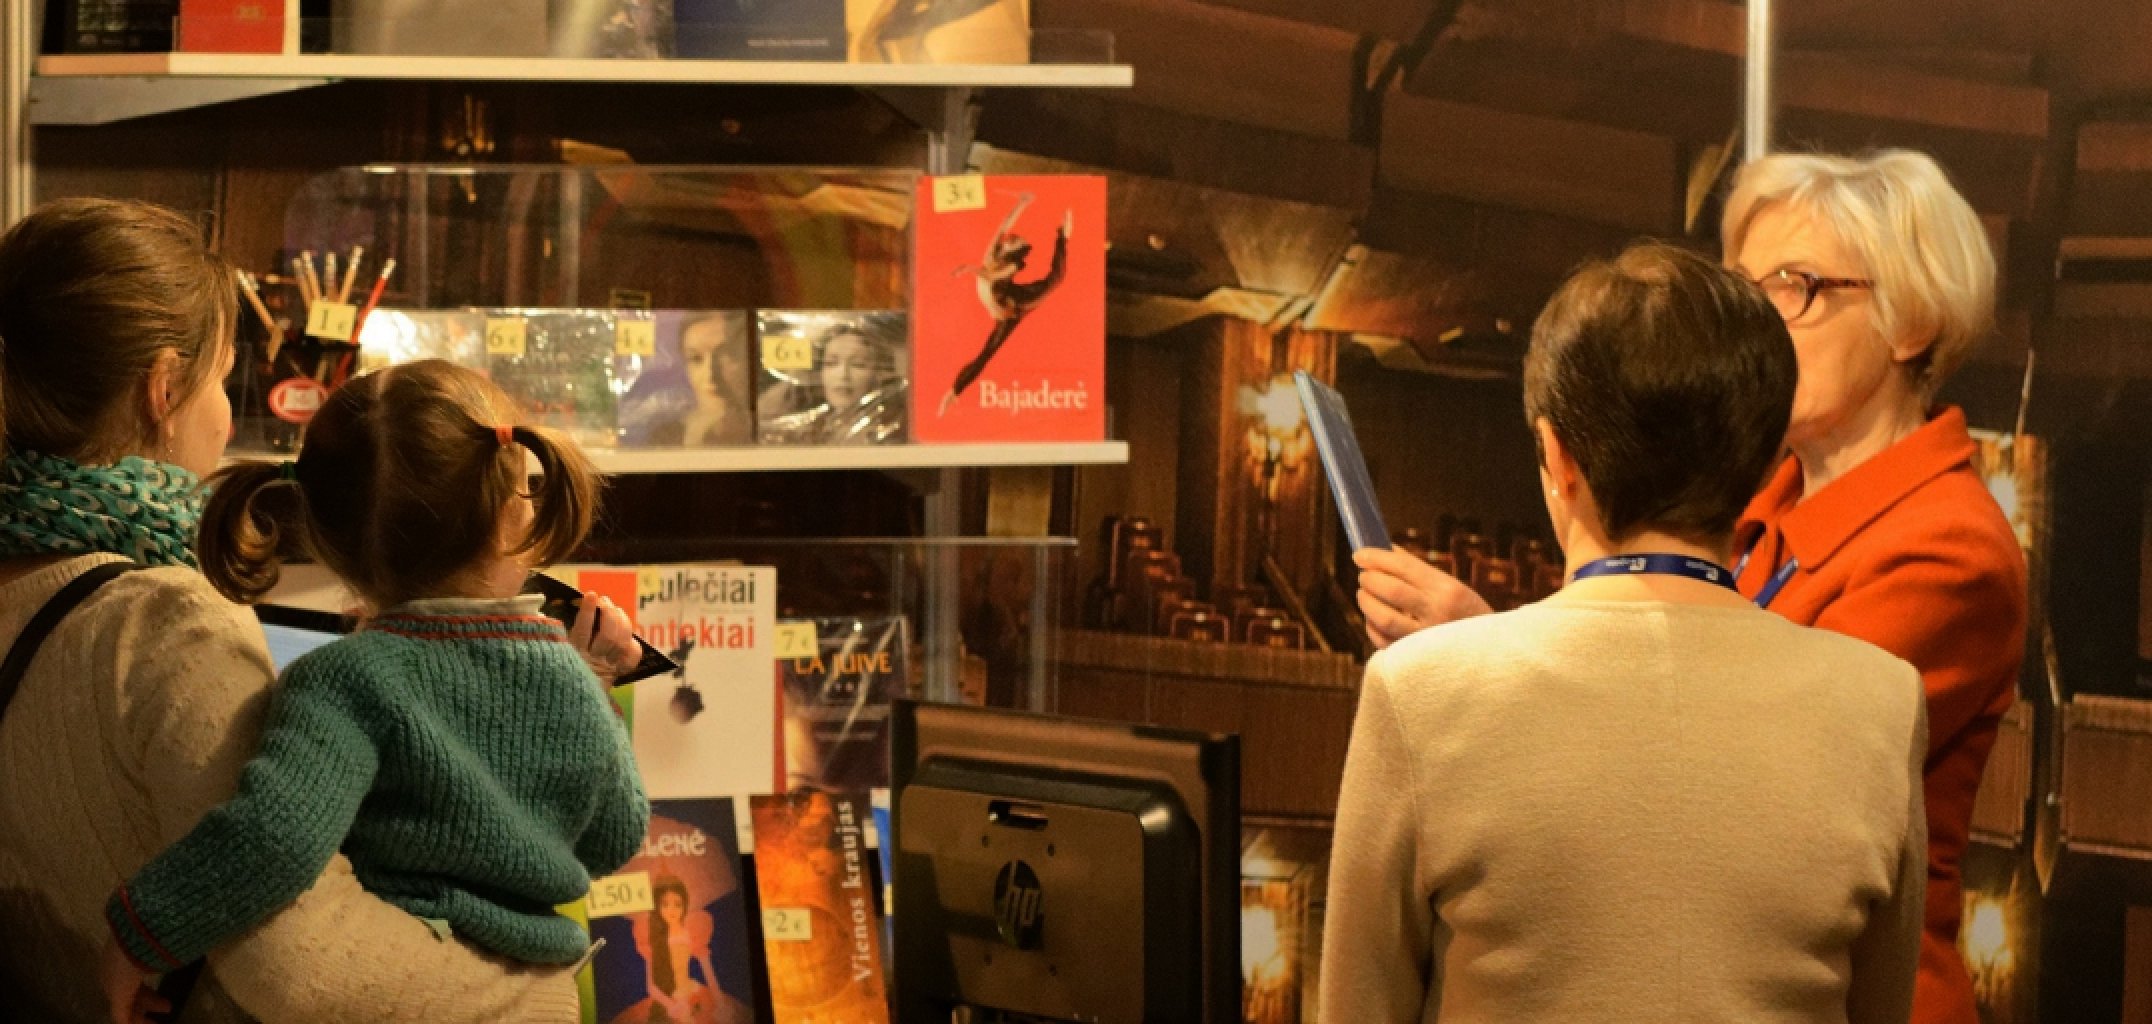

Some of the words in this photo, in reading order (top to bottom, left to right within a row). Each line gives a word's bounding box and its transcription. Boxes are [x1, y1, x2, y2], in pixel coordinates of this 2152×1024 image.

[946, 182, 961, 205] 3
[319, 308, 329, 332] 1
[489, 325, 503, 348] 6
[775, 342, 789, 361] 6
[980, 379, 1089, 416] Bajaderė
[781, 629, 795, 652] 7
[793, 656, 825, 675] LA
[832, 652, 893, 675] JUIVE
[834, 801, 862, 888] kraujas
[1001, 860, 1041, 940] hp
[775, 910, 788, 934] 2
[852, 897, 873, 982] Vienos
